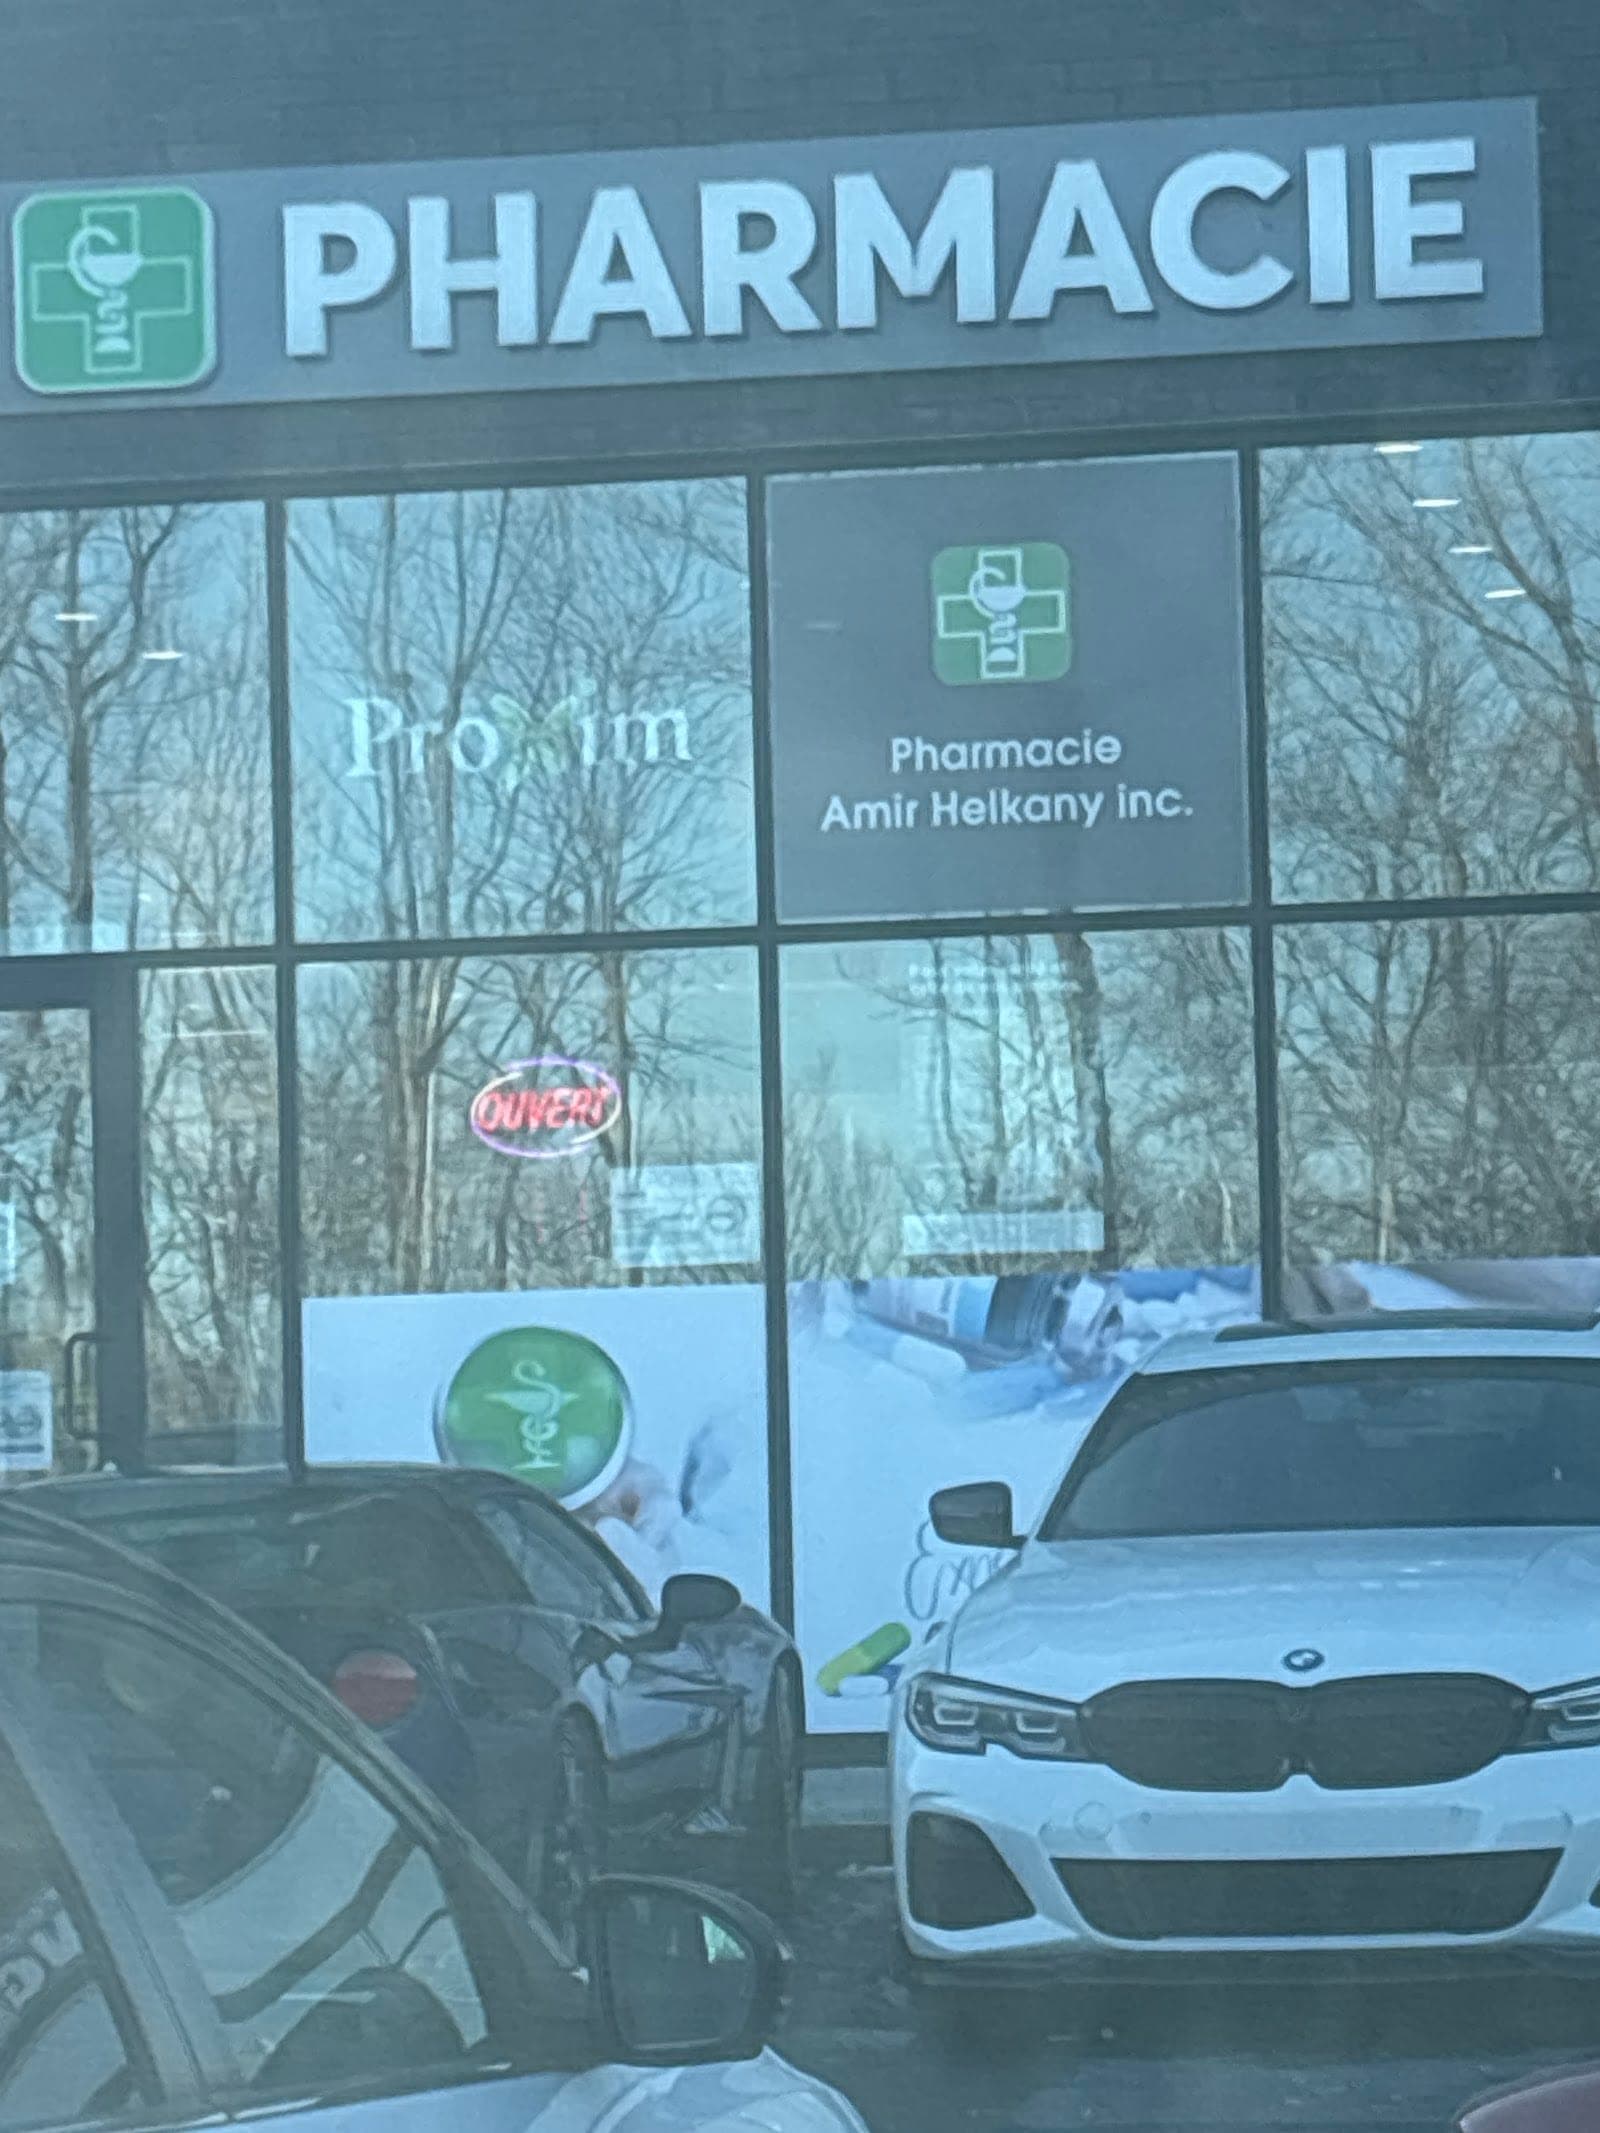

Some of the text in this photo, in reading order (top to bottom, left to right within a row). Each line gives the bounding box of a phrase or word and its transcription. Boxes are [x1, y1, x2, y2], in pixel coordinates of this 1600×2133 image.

[282, 136, 1484, 358] PHARMACIE
[346, 678, 693, 794] Proxim
[890, 729, 1122, 774] Pharmacie
[820, 783, 1194, 833] Amir Helkany inc.
[477, 1088, 610, 1132] OUVERT
